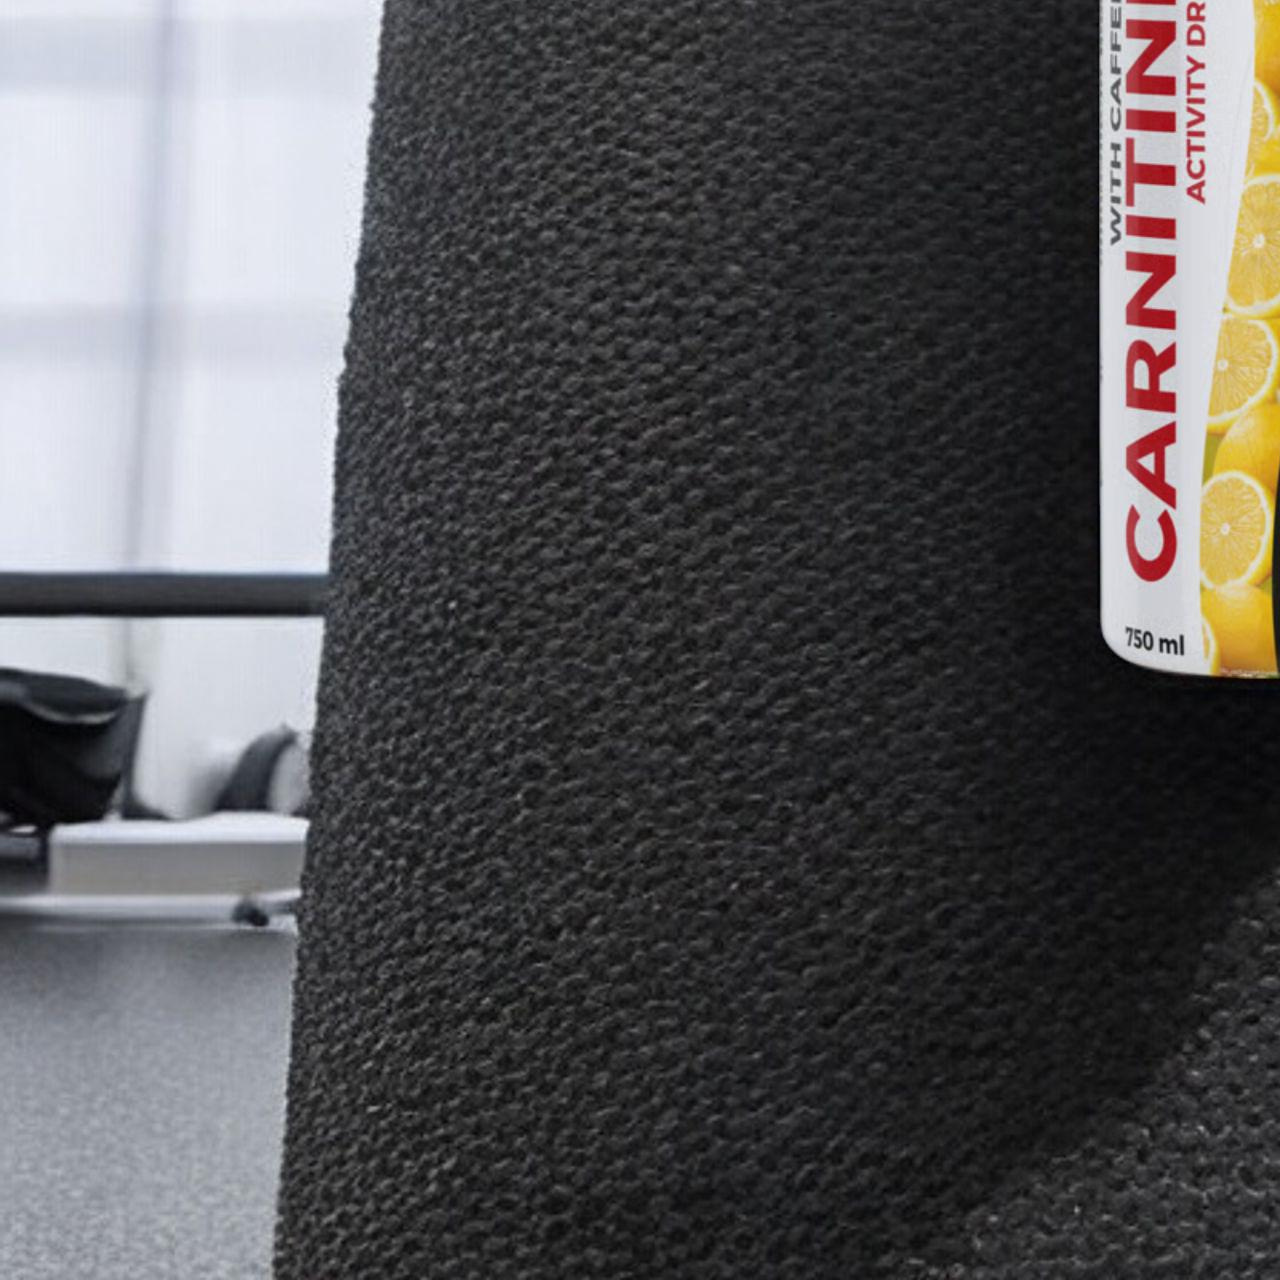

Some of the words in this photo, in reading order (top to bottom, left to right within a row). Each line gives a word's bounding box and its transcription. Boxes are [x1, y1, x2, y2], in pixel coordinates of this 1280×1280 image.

[1186, 55, 1207, 204] ACTIVITY
[1110, 143, 1123, 245] WITH
[1125, 626, 1154, 651] 750
[1159, 634, 1185, 656] ml
